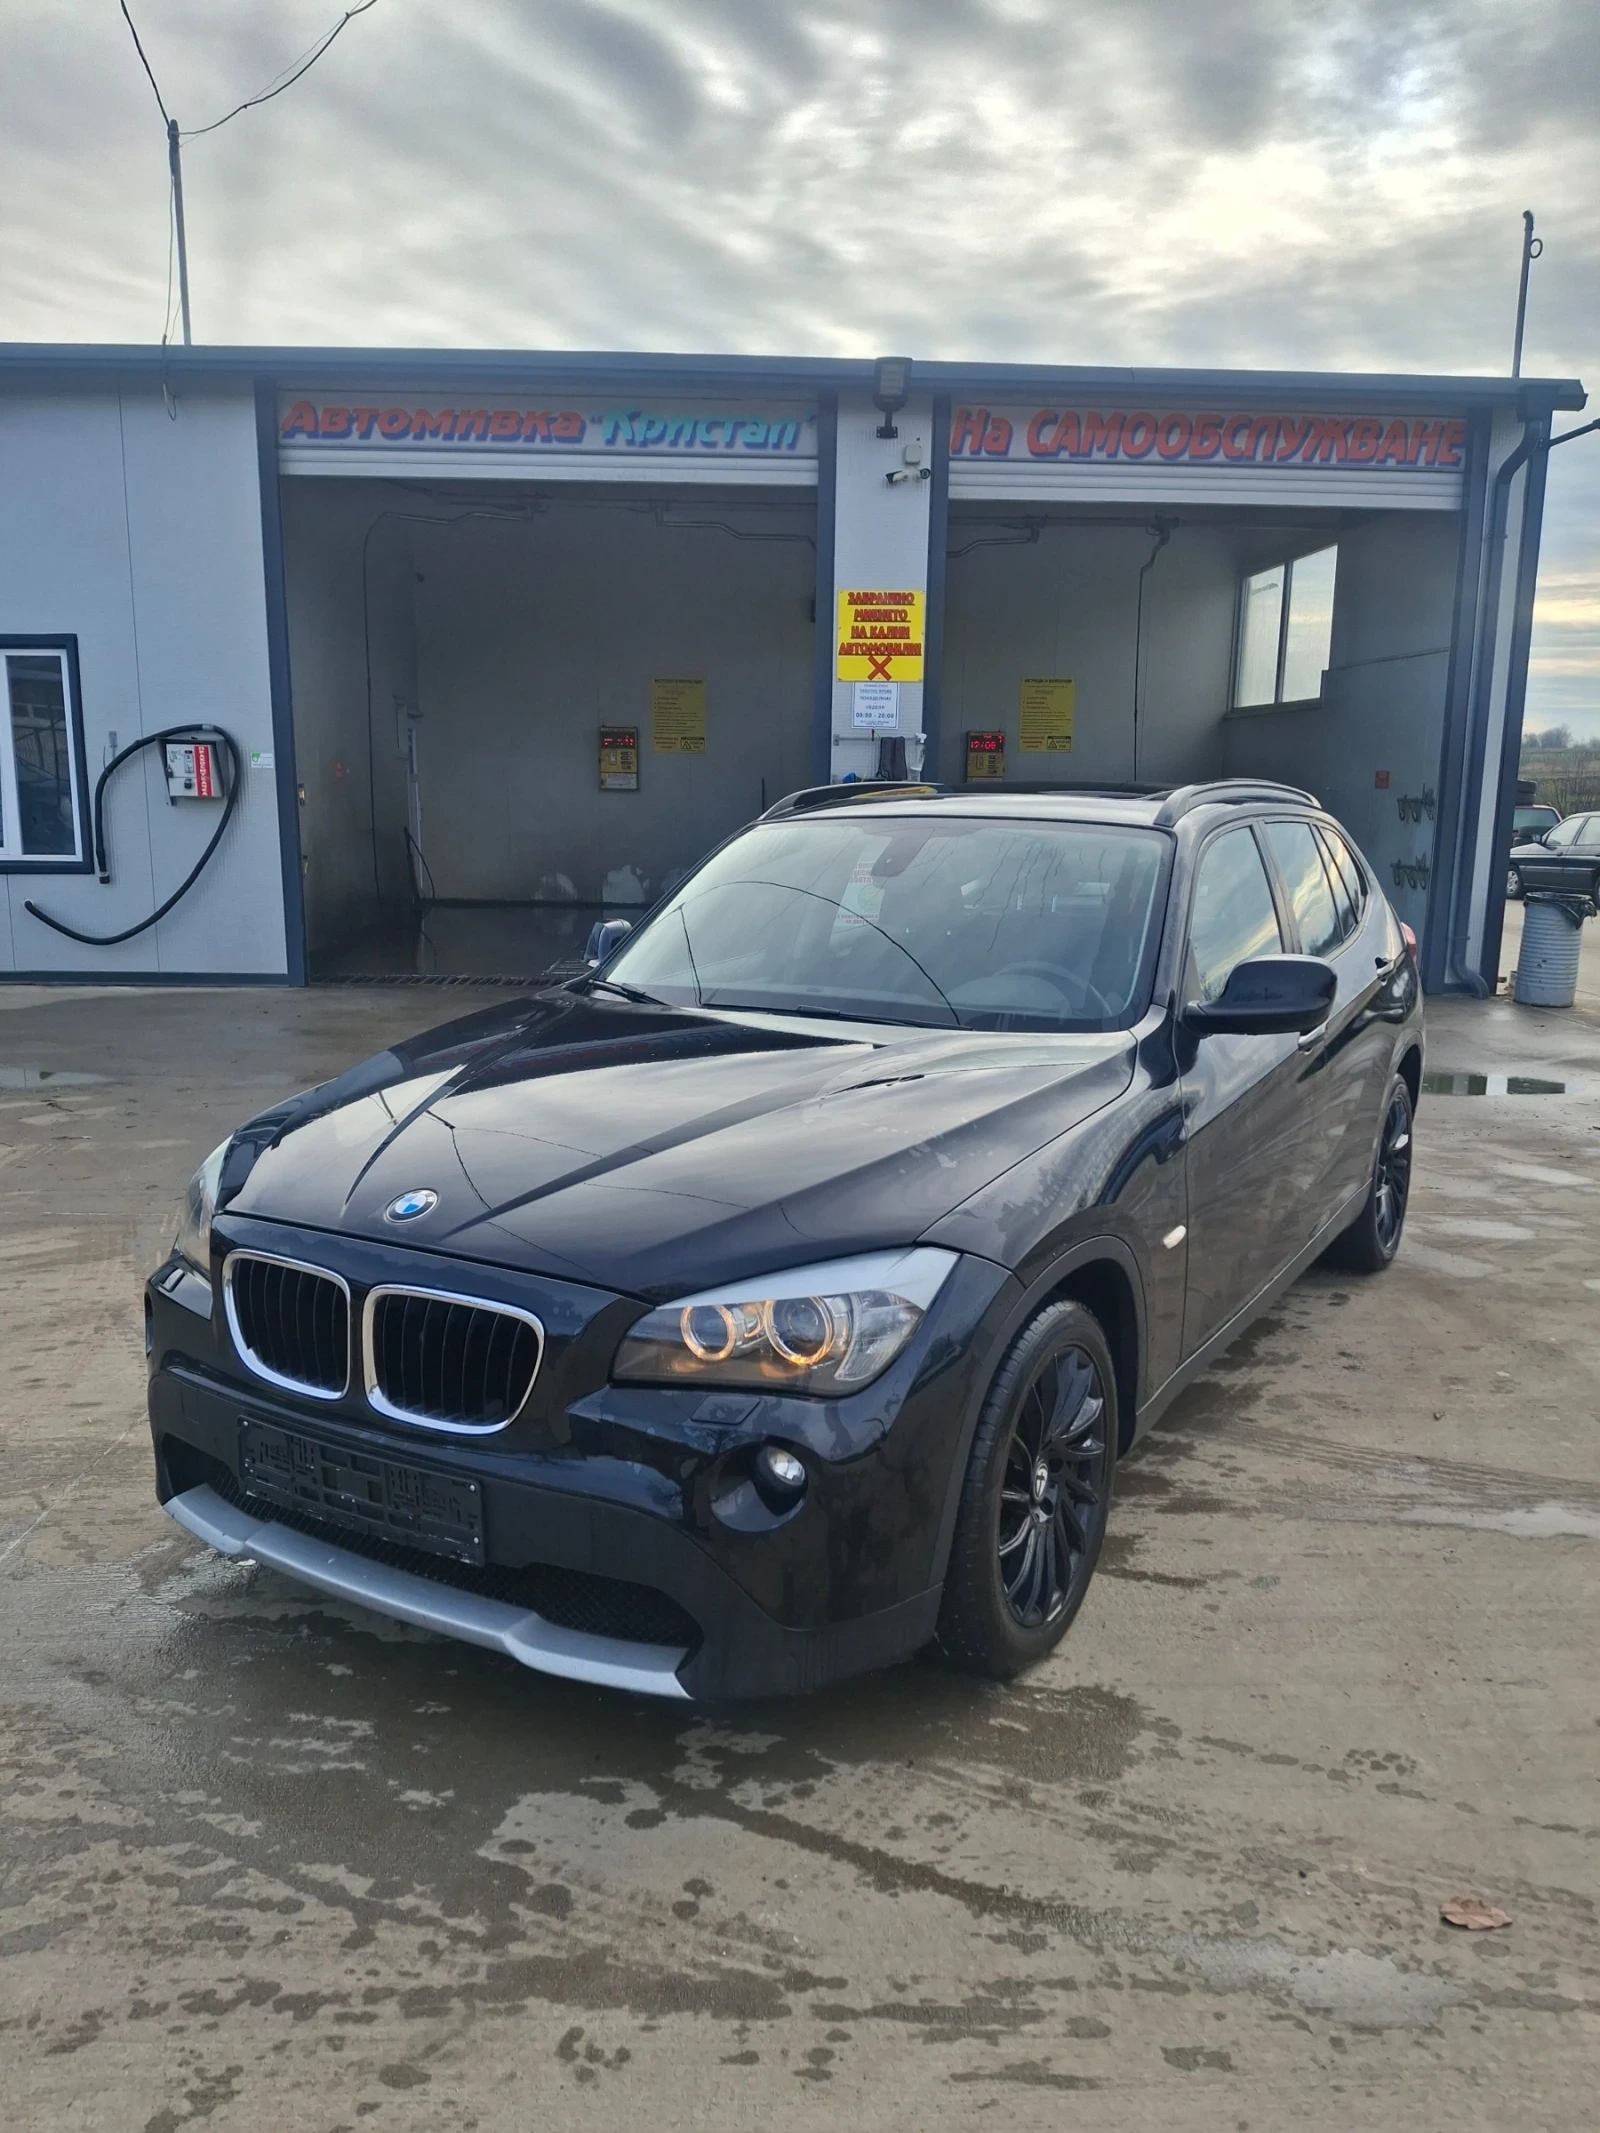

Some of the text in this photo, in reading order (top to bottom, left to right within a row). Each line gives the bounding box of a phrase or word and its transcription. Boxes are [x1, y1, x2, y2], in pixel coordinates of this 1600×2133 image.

[280, 400, 587, 444] Автомивка
[950, 407, 1466, 468] На САМООБСЛУЖВАНЕ
[847, 591, 915, 605] ЗАБРАНЕНО
[851, 625, 911, 639] НА КАЛНИ
